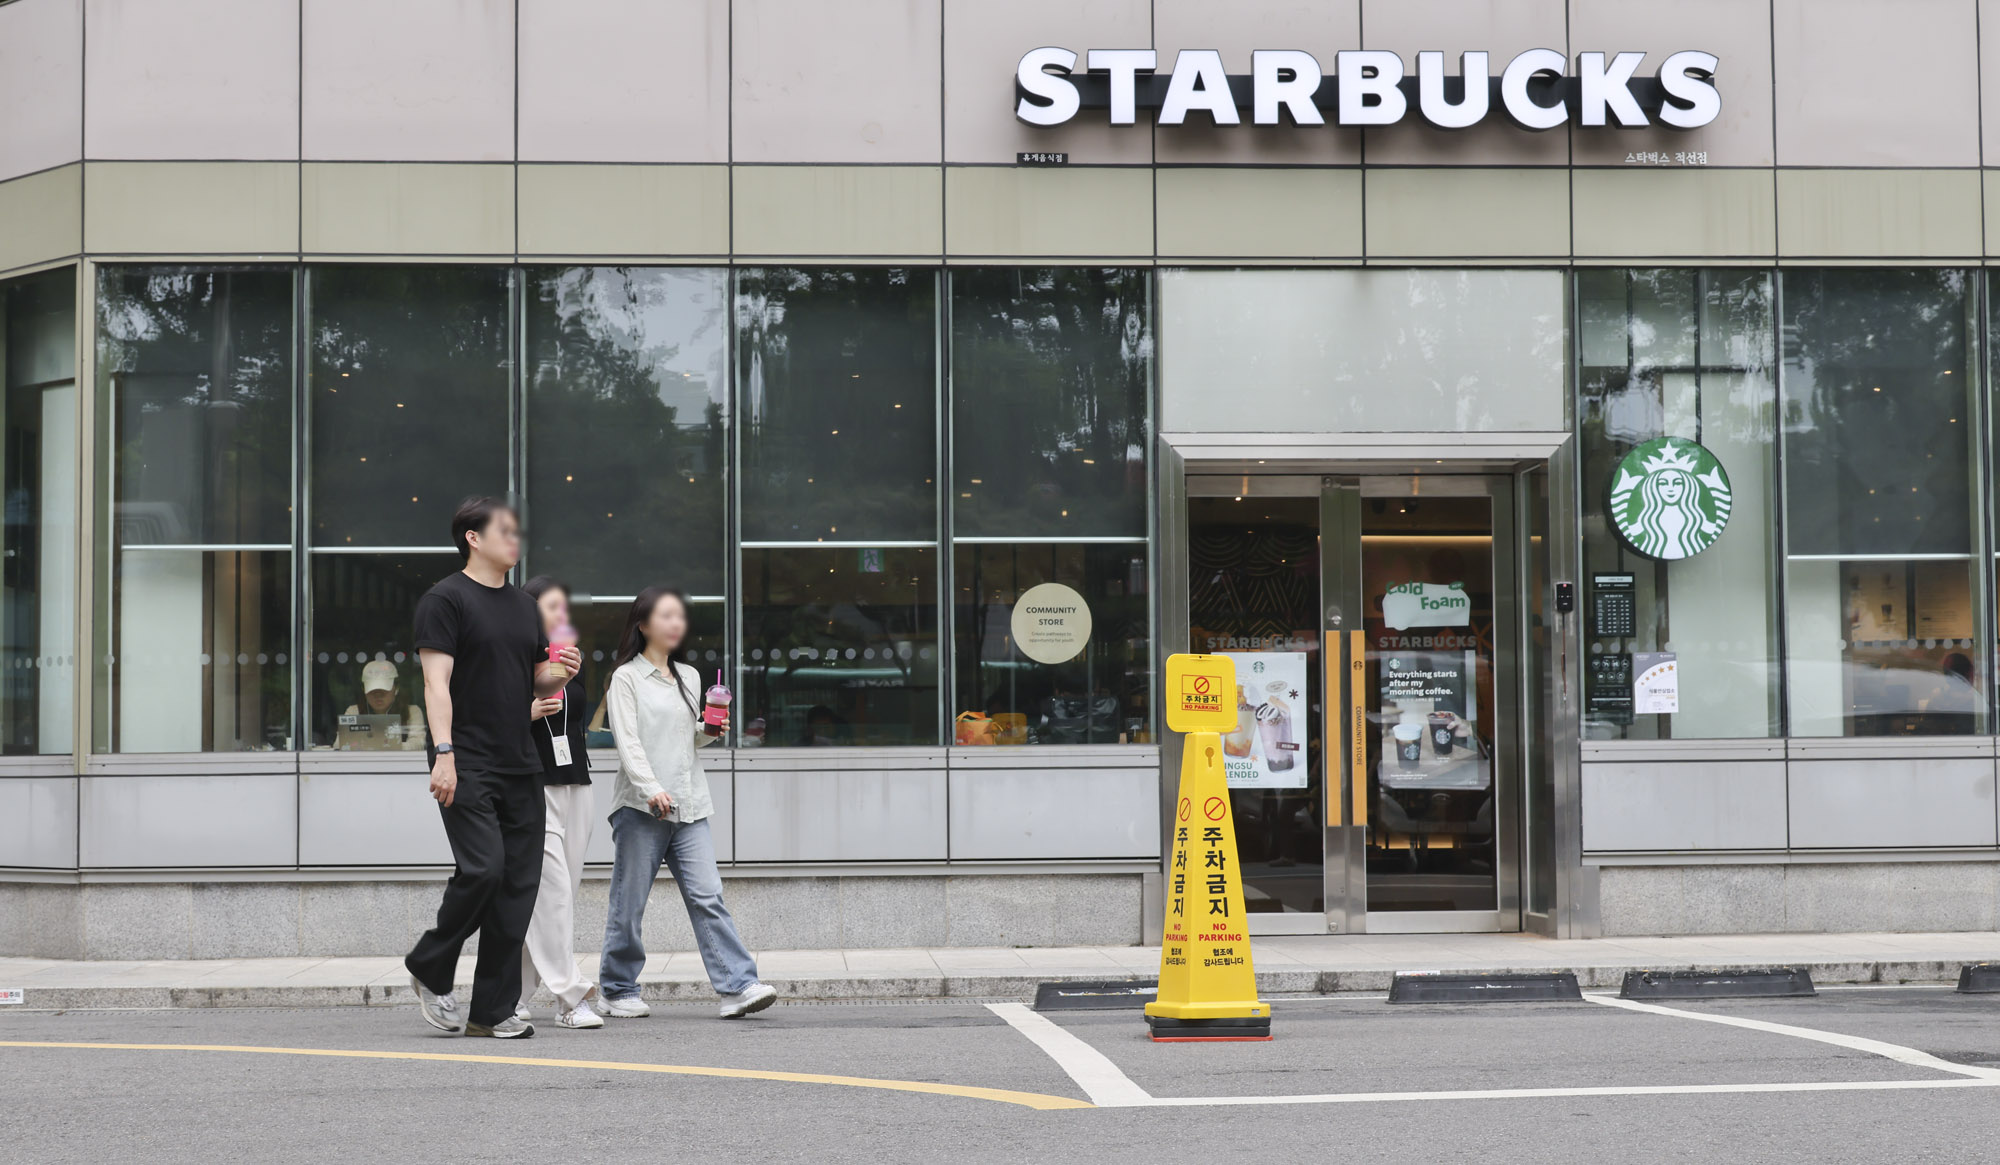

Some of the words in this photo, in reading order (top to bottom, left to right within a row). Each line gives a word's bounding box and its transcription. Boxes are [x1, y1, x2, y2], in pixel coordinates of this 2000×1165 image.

[1016, 46, 1722, 129] STARBUCKS
[1023, 153, 1063, 163] 휴게음식점
[1624, 151, 1671, 165] 스타벅스
[1674, 151, 1708, 165] 적선점
[1385, 580, 1424, 595] Cold
[1420, 596, 1466, 610] Foam
[1207, 637, 1305, 649] STARBUCKS
[1379, 636, 1477, 648] STARBUCKS
[1388, 670, 1433, 680] Everything
[1433, 670, 1458, 678] starts
[1388, 679, 1410, 688] after
[1410, 681, 1424, 689] my
[1389, 687, 1424, 696] morning
[1424, 687, 1454, 695] coffee.
[1186, 695, 1218, 703] 주차금지
[1224, 762, 1253, 770] INGSU
[1225, 770, 1259, 779] LENDED
[1173, 828, 1188, 918] 주차금지
[1203, 827, 1229, 918] 주차금지
[1173, 923, 1182, 931] NO
[1212, 923, 1227, 931] NO
[1166, 934, 1187, 942] PARKING
[1198, 933, 1242, 942] PARKING
[1213, 948, 1233, 956] 협조에
[1204, 957, 1244, 966] 감사드립니다
